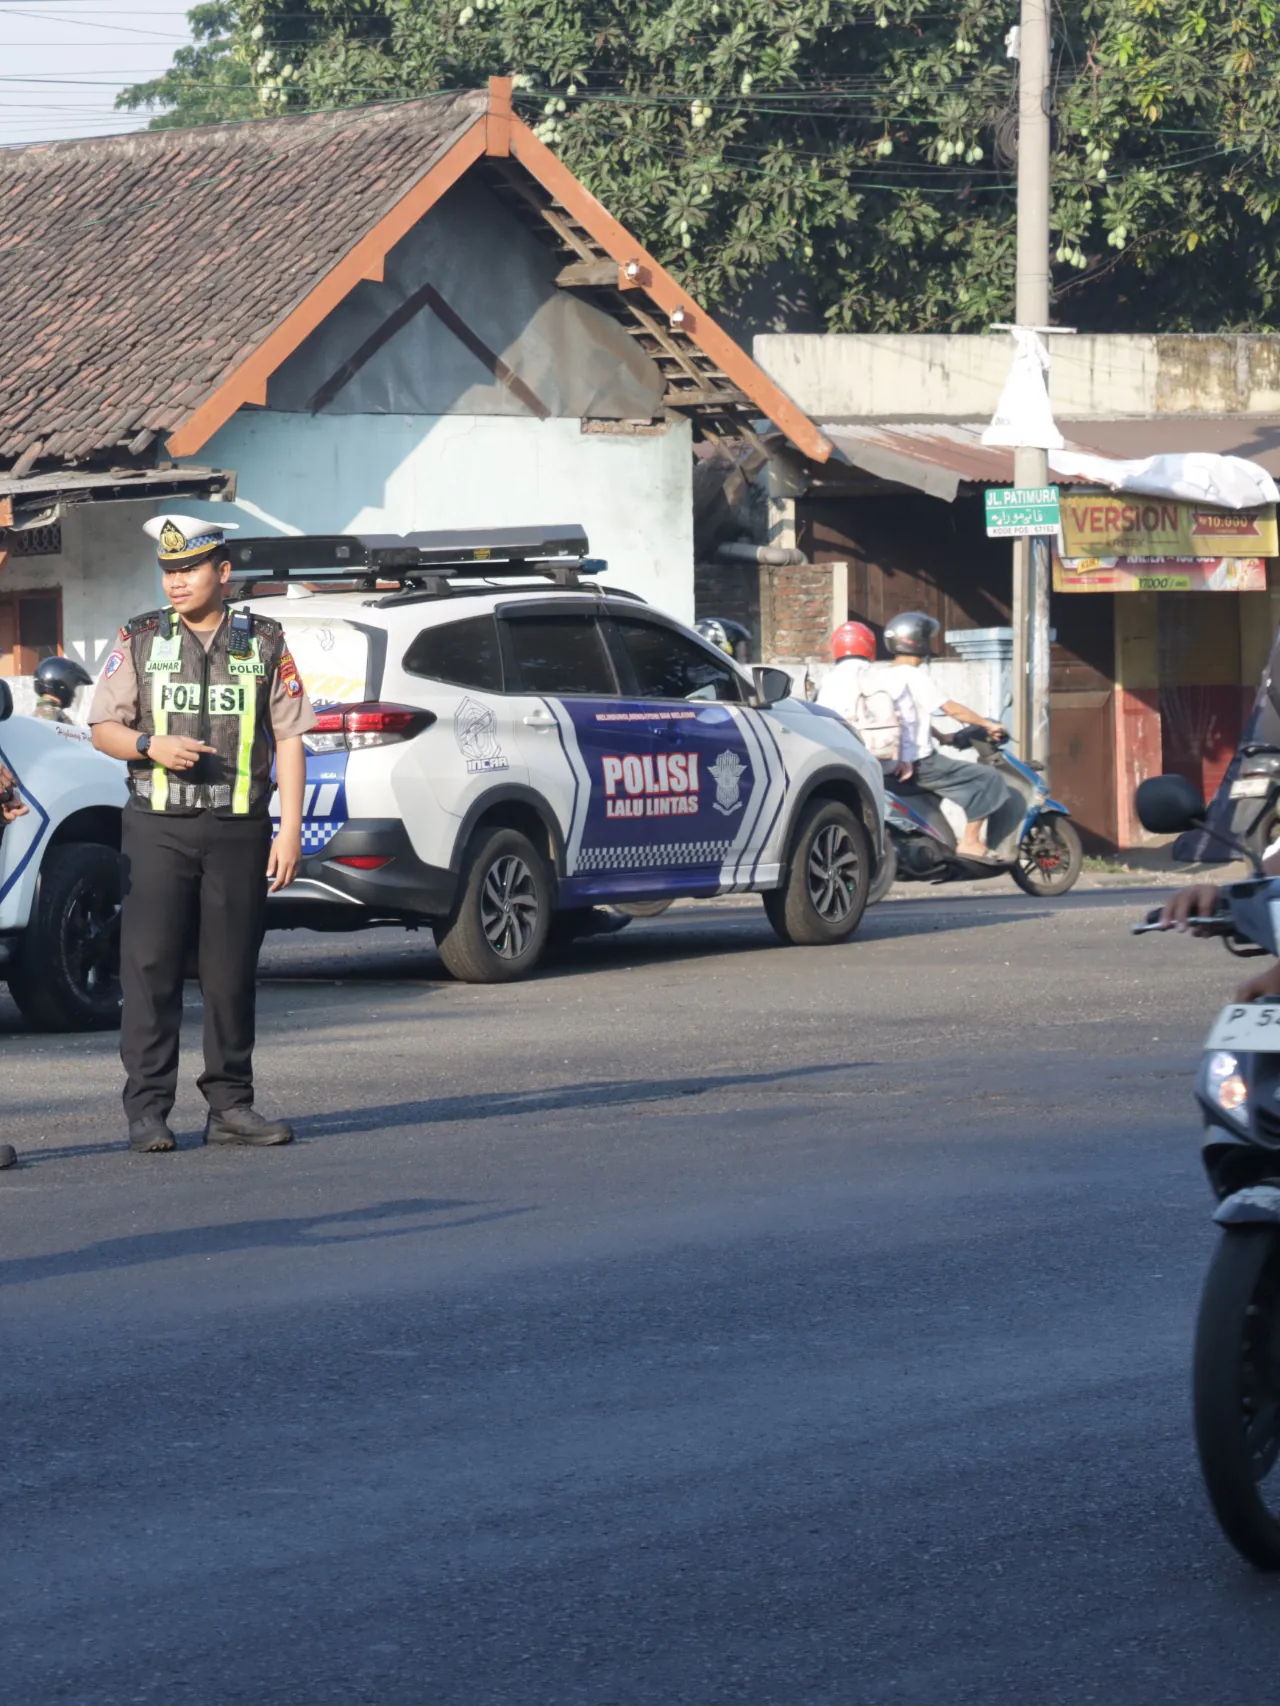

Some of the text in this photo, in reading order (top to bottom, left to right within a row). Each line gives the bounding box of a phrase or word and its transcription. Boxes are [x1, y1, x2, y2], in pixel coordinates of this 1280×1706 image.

[987, 488, 1057, 506] JL. PATIMURA
[147, 662, 179, 671] JAUHAR
[230, 665, 263, 674] POLRI
[601, 752, 700, 796] POLISI
[606, 795, 699, 818] LALU LINTAS
[1226, 1008, 1247, 1025] P
